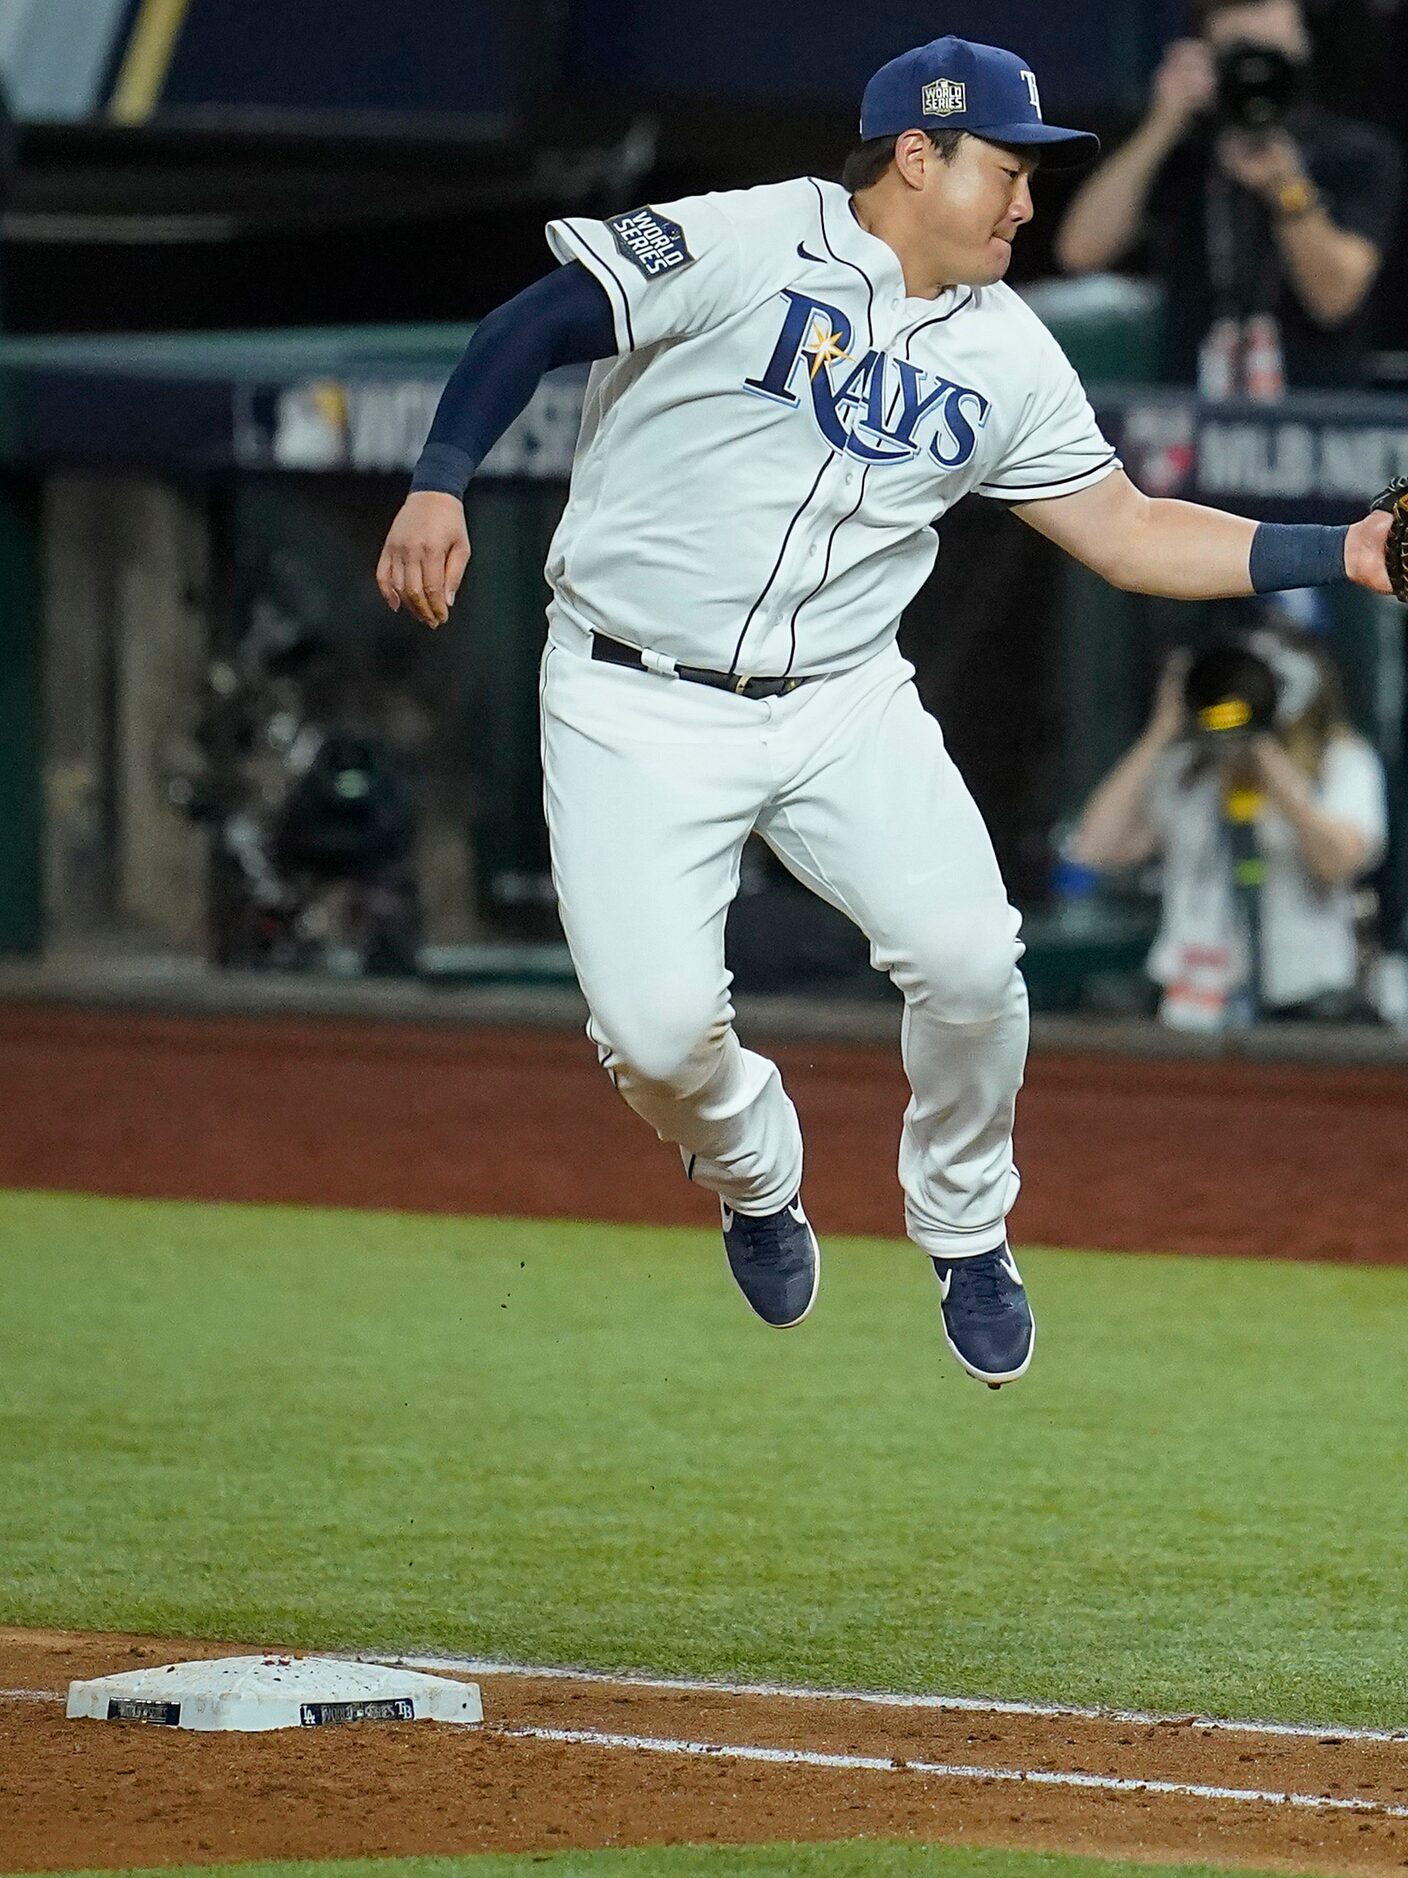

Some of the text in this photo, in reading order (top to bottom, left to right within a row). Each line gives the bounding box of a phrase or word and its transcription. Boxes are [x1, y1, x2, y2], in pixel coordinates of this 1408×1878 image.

[924, 86, 962, 99] WORLD
[925, 97, 963, 111] SERIES
[612, 218, 668, 274] SERIES
[632, 211, 684, 267] WORLD
[742, 287, 993, 472] RAYS
[1199, 420, 1315, 500] MLB
[302, 1704, 316, 1724] LA
[395, 1701, 412, 1720] TB
